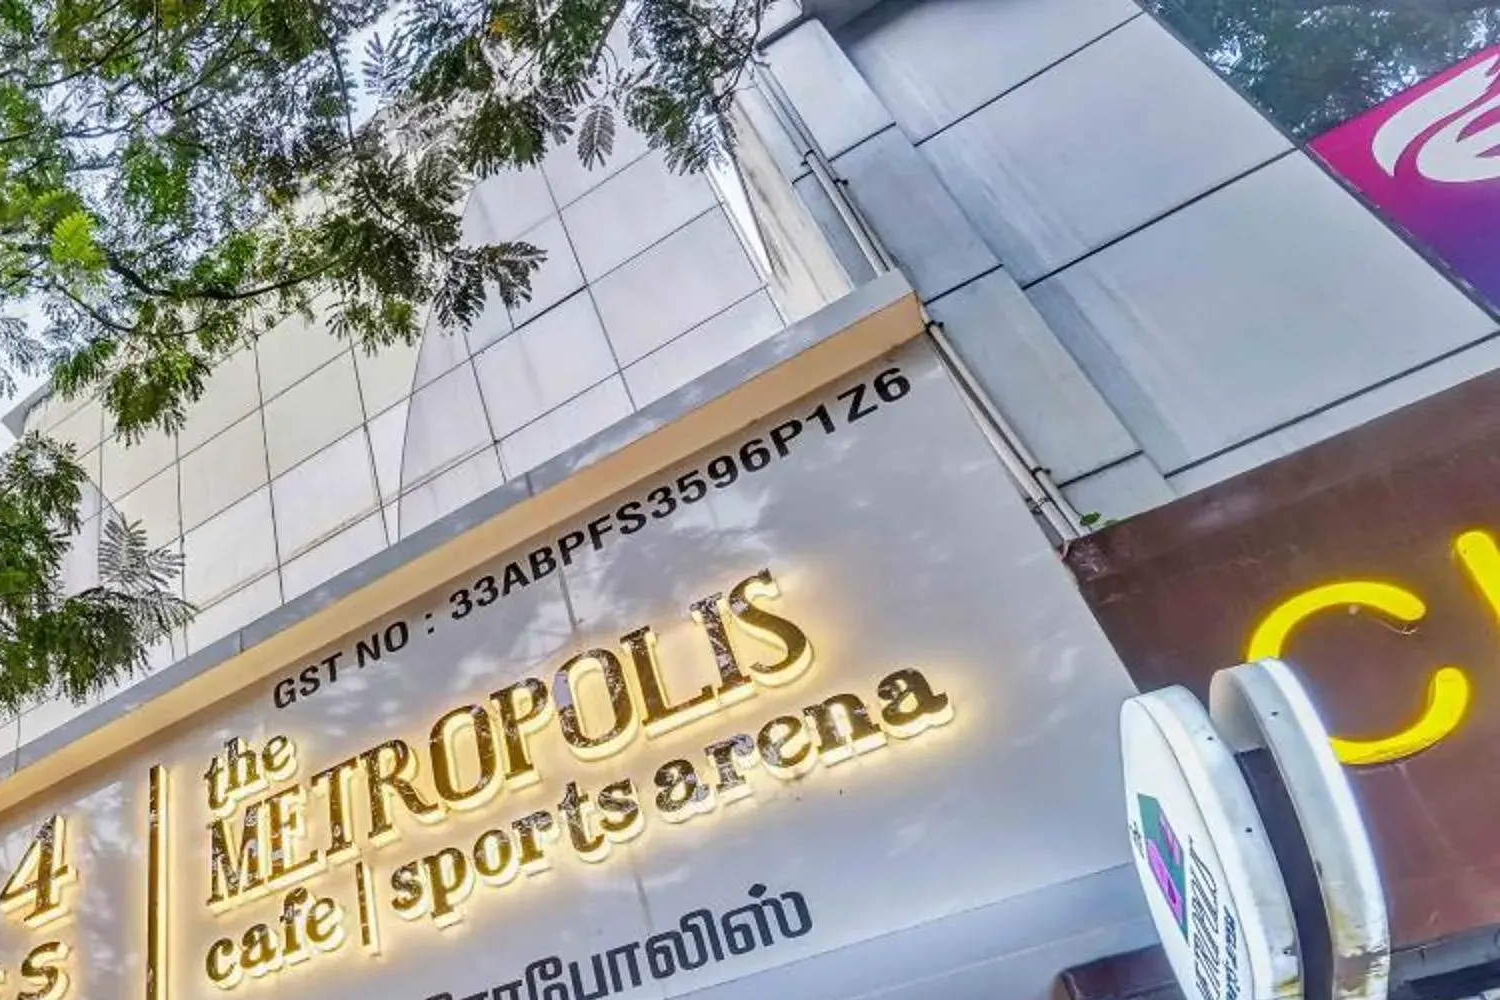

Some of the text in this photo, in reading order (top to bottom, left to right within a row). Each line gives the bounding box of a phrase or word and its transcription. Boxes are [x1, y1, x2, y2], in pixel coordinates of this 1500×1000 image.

[272, 652, 344, 710] GST
[356, 620, 410, 670] NO
[448, 365, 913, 621] 33ABPFS3596P1Z6
[204, 732, 298, 806] the
[204, 666, 953, 990] cafe sports arena
[205, 568, 814, 912] METROPOLIS
